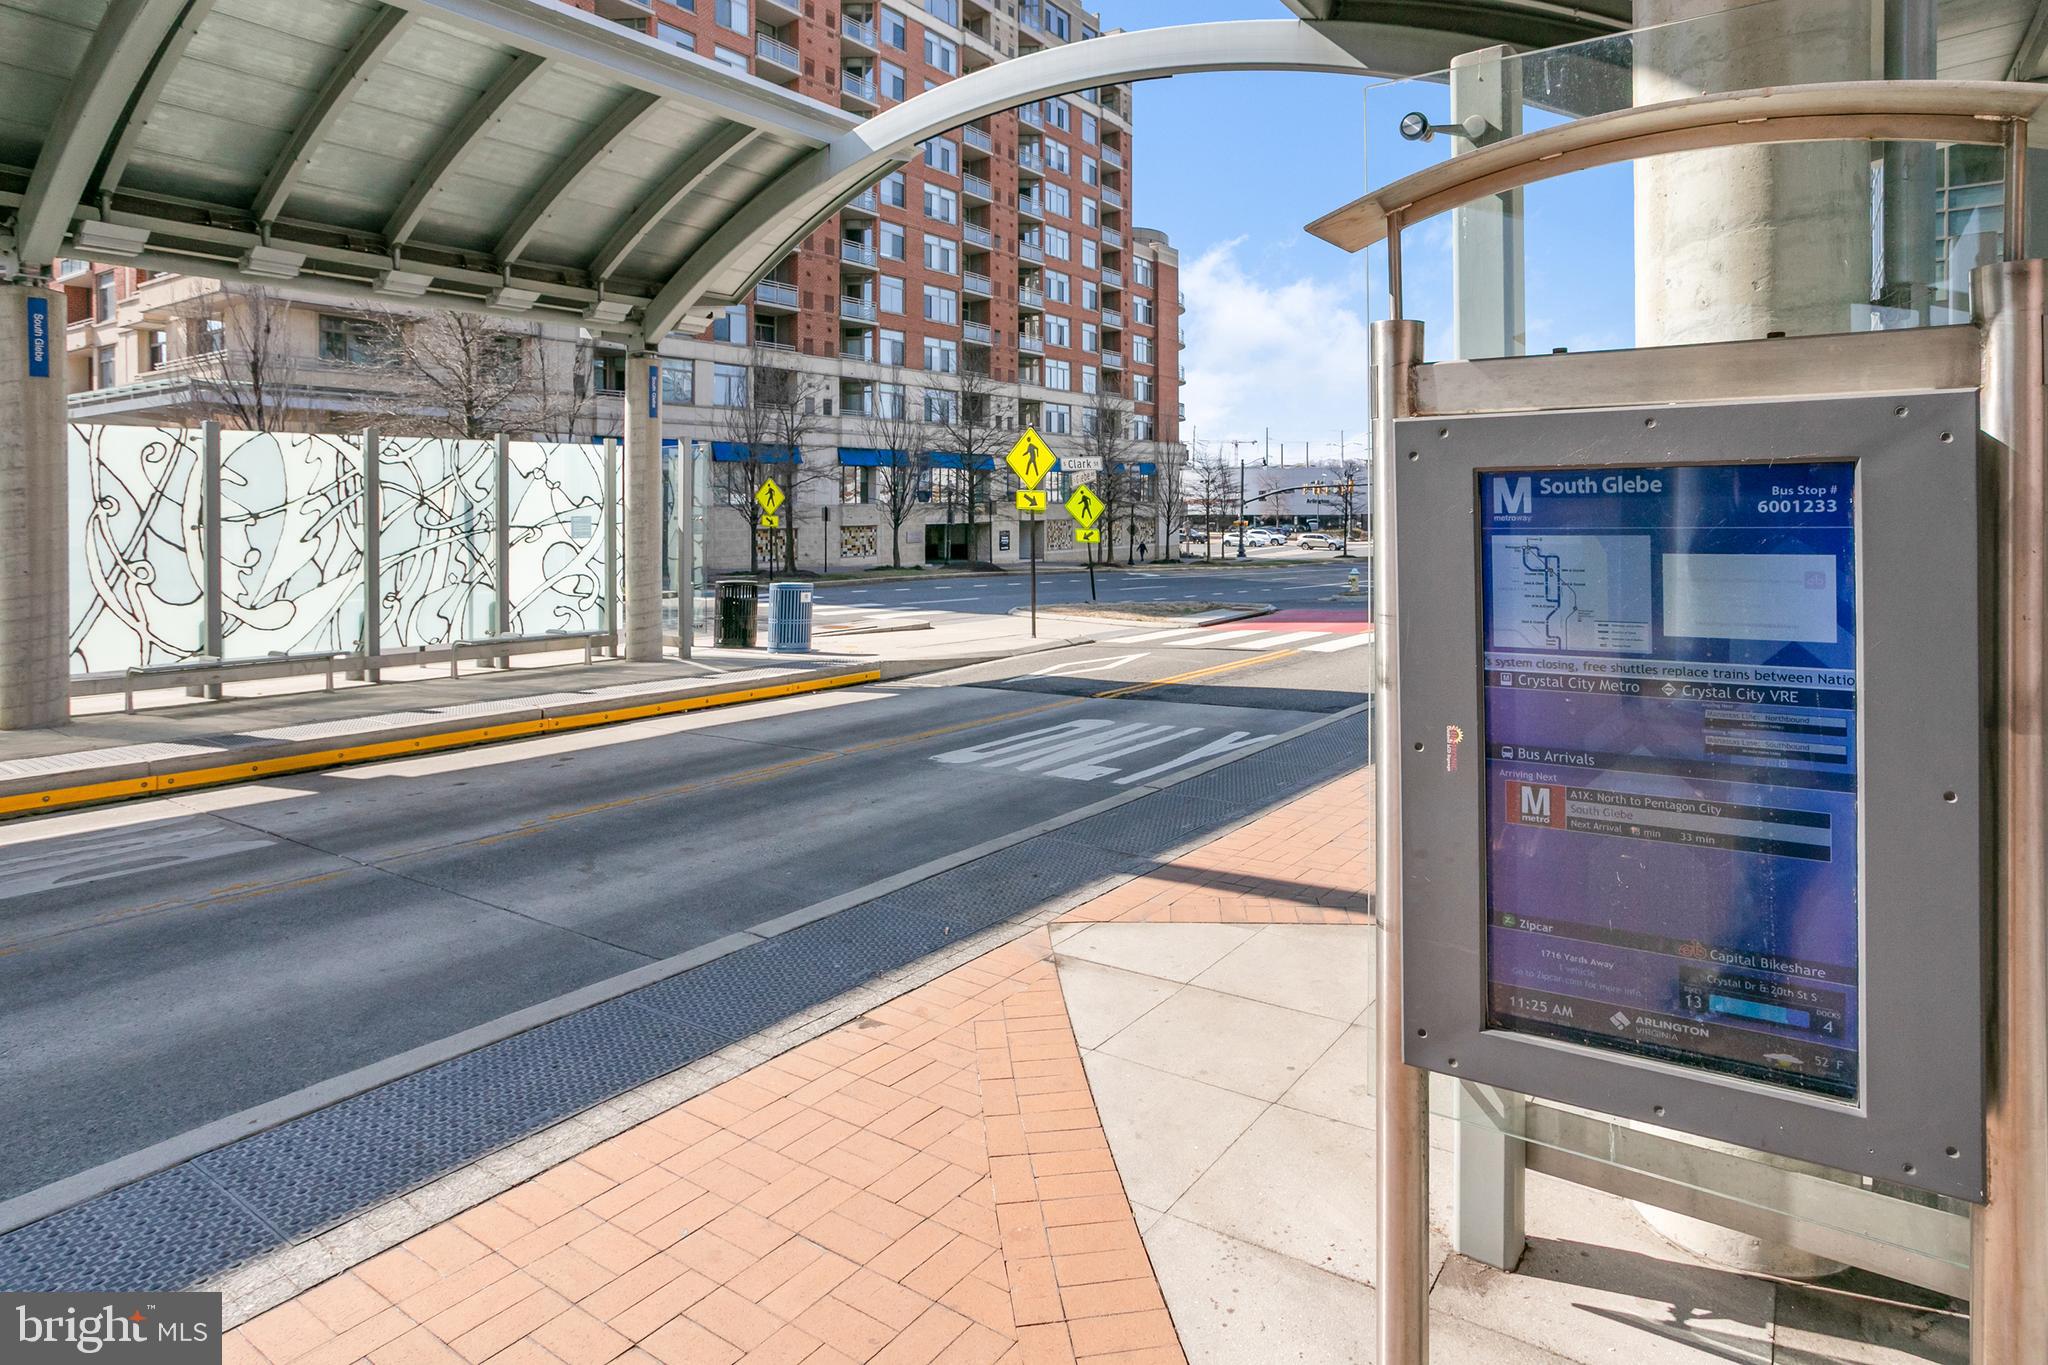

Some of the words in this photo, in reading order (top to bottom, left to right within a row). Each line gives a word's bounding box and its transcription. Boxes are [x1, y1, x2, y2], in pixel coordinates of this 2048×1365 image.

[33, 313, 44, 337] South
[34, 338, 45, 362] Glebe
[1068, 459, 1092, 469] Clark
[1540, 476, 1597, 495] South
[1602, 475, 1663, 493] Glebe
[1772, 486, 1794, 496] Bus
[1797, 485, 1827, 498] Stop
[1830, 485, 1838, 494] #
[1493, 477, 1532, 513] M
[1757, 499, 1838, 513] 6001233
[1493, 514, 1533, 523] metroway
[1495, 655, 1533, 669] system
[1536, 659, 1579, 673] closing,
[1583, 660, 1607, 672] free
[1610, 663, 1658, 676] shuttles
[1662, 665, 1709, 680] replace
[1713, 668, 1750, 681] trains
[1754, 669, 1813, 684] between
[1817, 674, 1855, 687] Natio
[1518, 674, 1564, 689] Crystal
[1568, 676, 1596, 693] City
[1599, 679, 1640, 694] Metro
[1682, 684, 1730, 700] Crystal
[1736, 687, 1766, 704] City
[1769, 690, 1799, 703] VRE
[1764, 713, 1810, 724] Northbound
[928, 719, 1278, 784] ONLY
[1765, 740, 1810, 751] Southbound
[1518, 748, 1541, 760] Bus
[1544, 750, 1596, 766] Arrivals
[1499, 769, 1533, 781] Arriving
[1536, 772, 1558, 782] Next
[1521, 786, 1550, 816] M
[1597, 793, 1627, 805] North
[1630, 797, 1641, 806] to
[1644, 799, 1696, 814] Pentagon
[1699, 803, 1722, 817] City
[1522, 815, 1551, 824] metro
[1570, 805, 1600, 817] South
[1602, 808, 1634, 820] Glebe
[1570, 820, 1592, 830] Next
[1593, 821, 1622, 833] Arrival
[1643, 829, 1661, 838] min
[1679, 832, 1692, 842] 33
[1695, 834, 1716, 845] min
[1520, 918, 1554, 934] Zipcar
[1541, 950, 1562, 960] 1716
[1564, 953, 1588, 965] Yards
[1590, 959, 1615, 970] Away
[1710, 949, 1756, 969] Capital
[1760, 957, 1827, 979] Bikeshare
[1706, 974, 1741, 989] Crystal
[1744, 981, 1756, 991] Dr
[1770, 985, 1795, 998] 20th
[1797, 991, 1808, 1001] St
[1810, 993, 1818, 1002] S
[1509, 996, 1548, 1013] 11:25
[1552, 1004, 1574, 1018] AM
[1685, 995, 1702, 1009] 13
[1816, 1009, 1841, 1020] DOCKS
[1635, 1016, 1710, 1037] ARLINGTON
[1635, 1026, 1679, 1041] VIRGINIA
[1823, 1021, 1833, 1033] 4
[1814, 1055, 1830, 1067] 52
